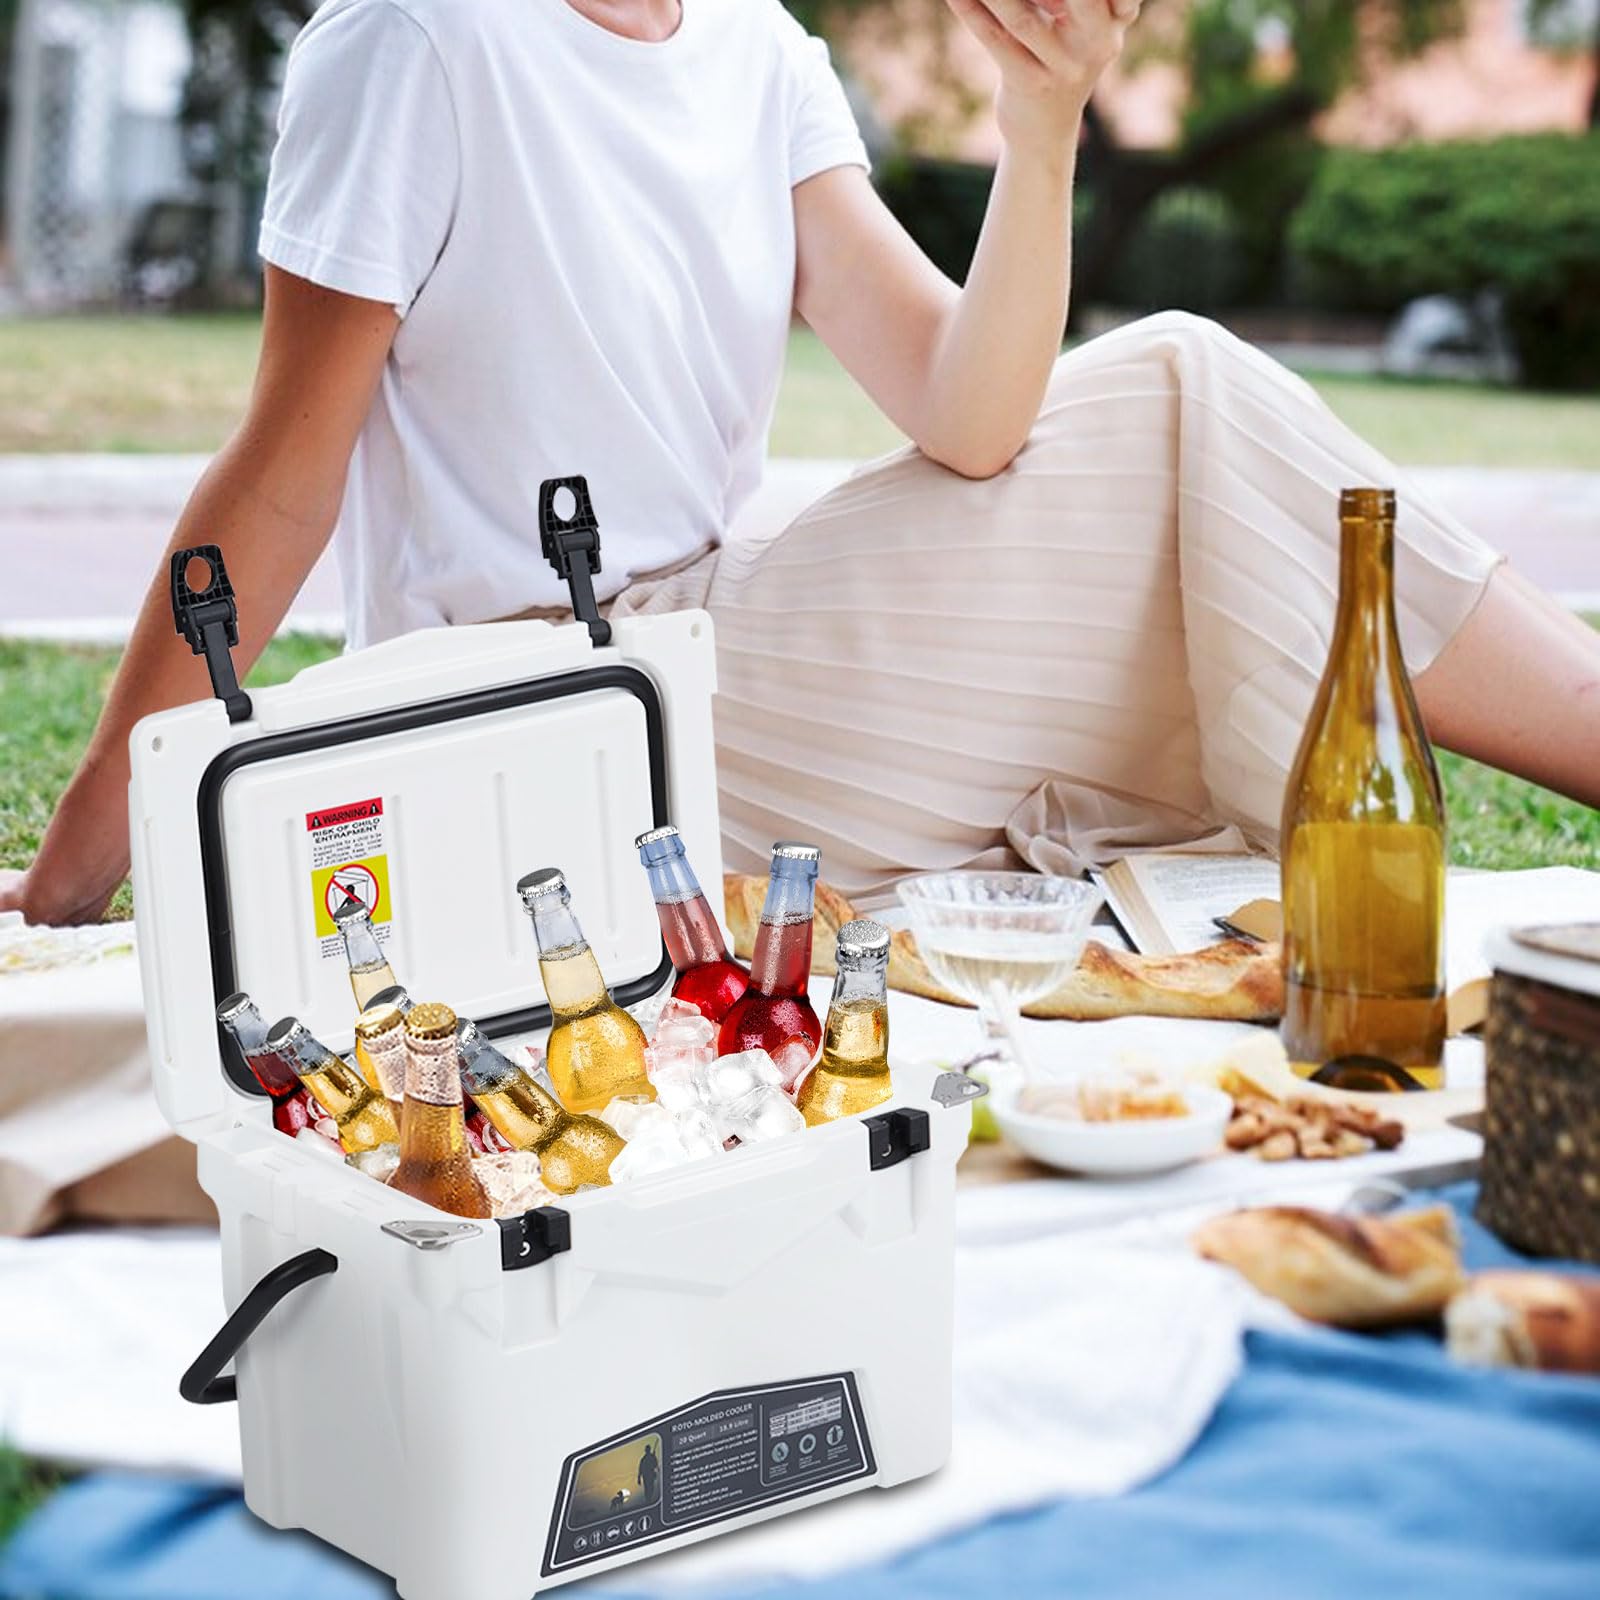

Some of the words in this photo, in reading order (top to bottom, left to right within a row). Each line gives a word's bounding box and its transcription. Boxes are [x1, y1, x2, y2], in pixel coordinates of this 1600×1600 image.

[322, 806, 368, 825] WARNING
[312, 827, 335, 838] RISK
[336, 824, 350, 832] OF
[351, 817, 381, 829] CHILD
[314, 825, 377, 844] ENTRAPMENT
[672, 1411, 725, 1433] ROTO-MOLDED
[725, 1402, 753, 1417] COOLER
